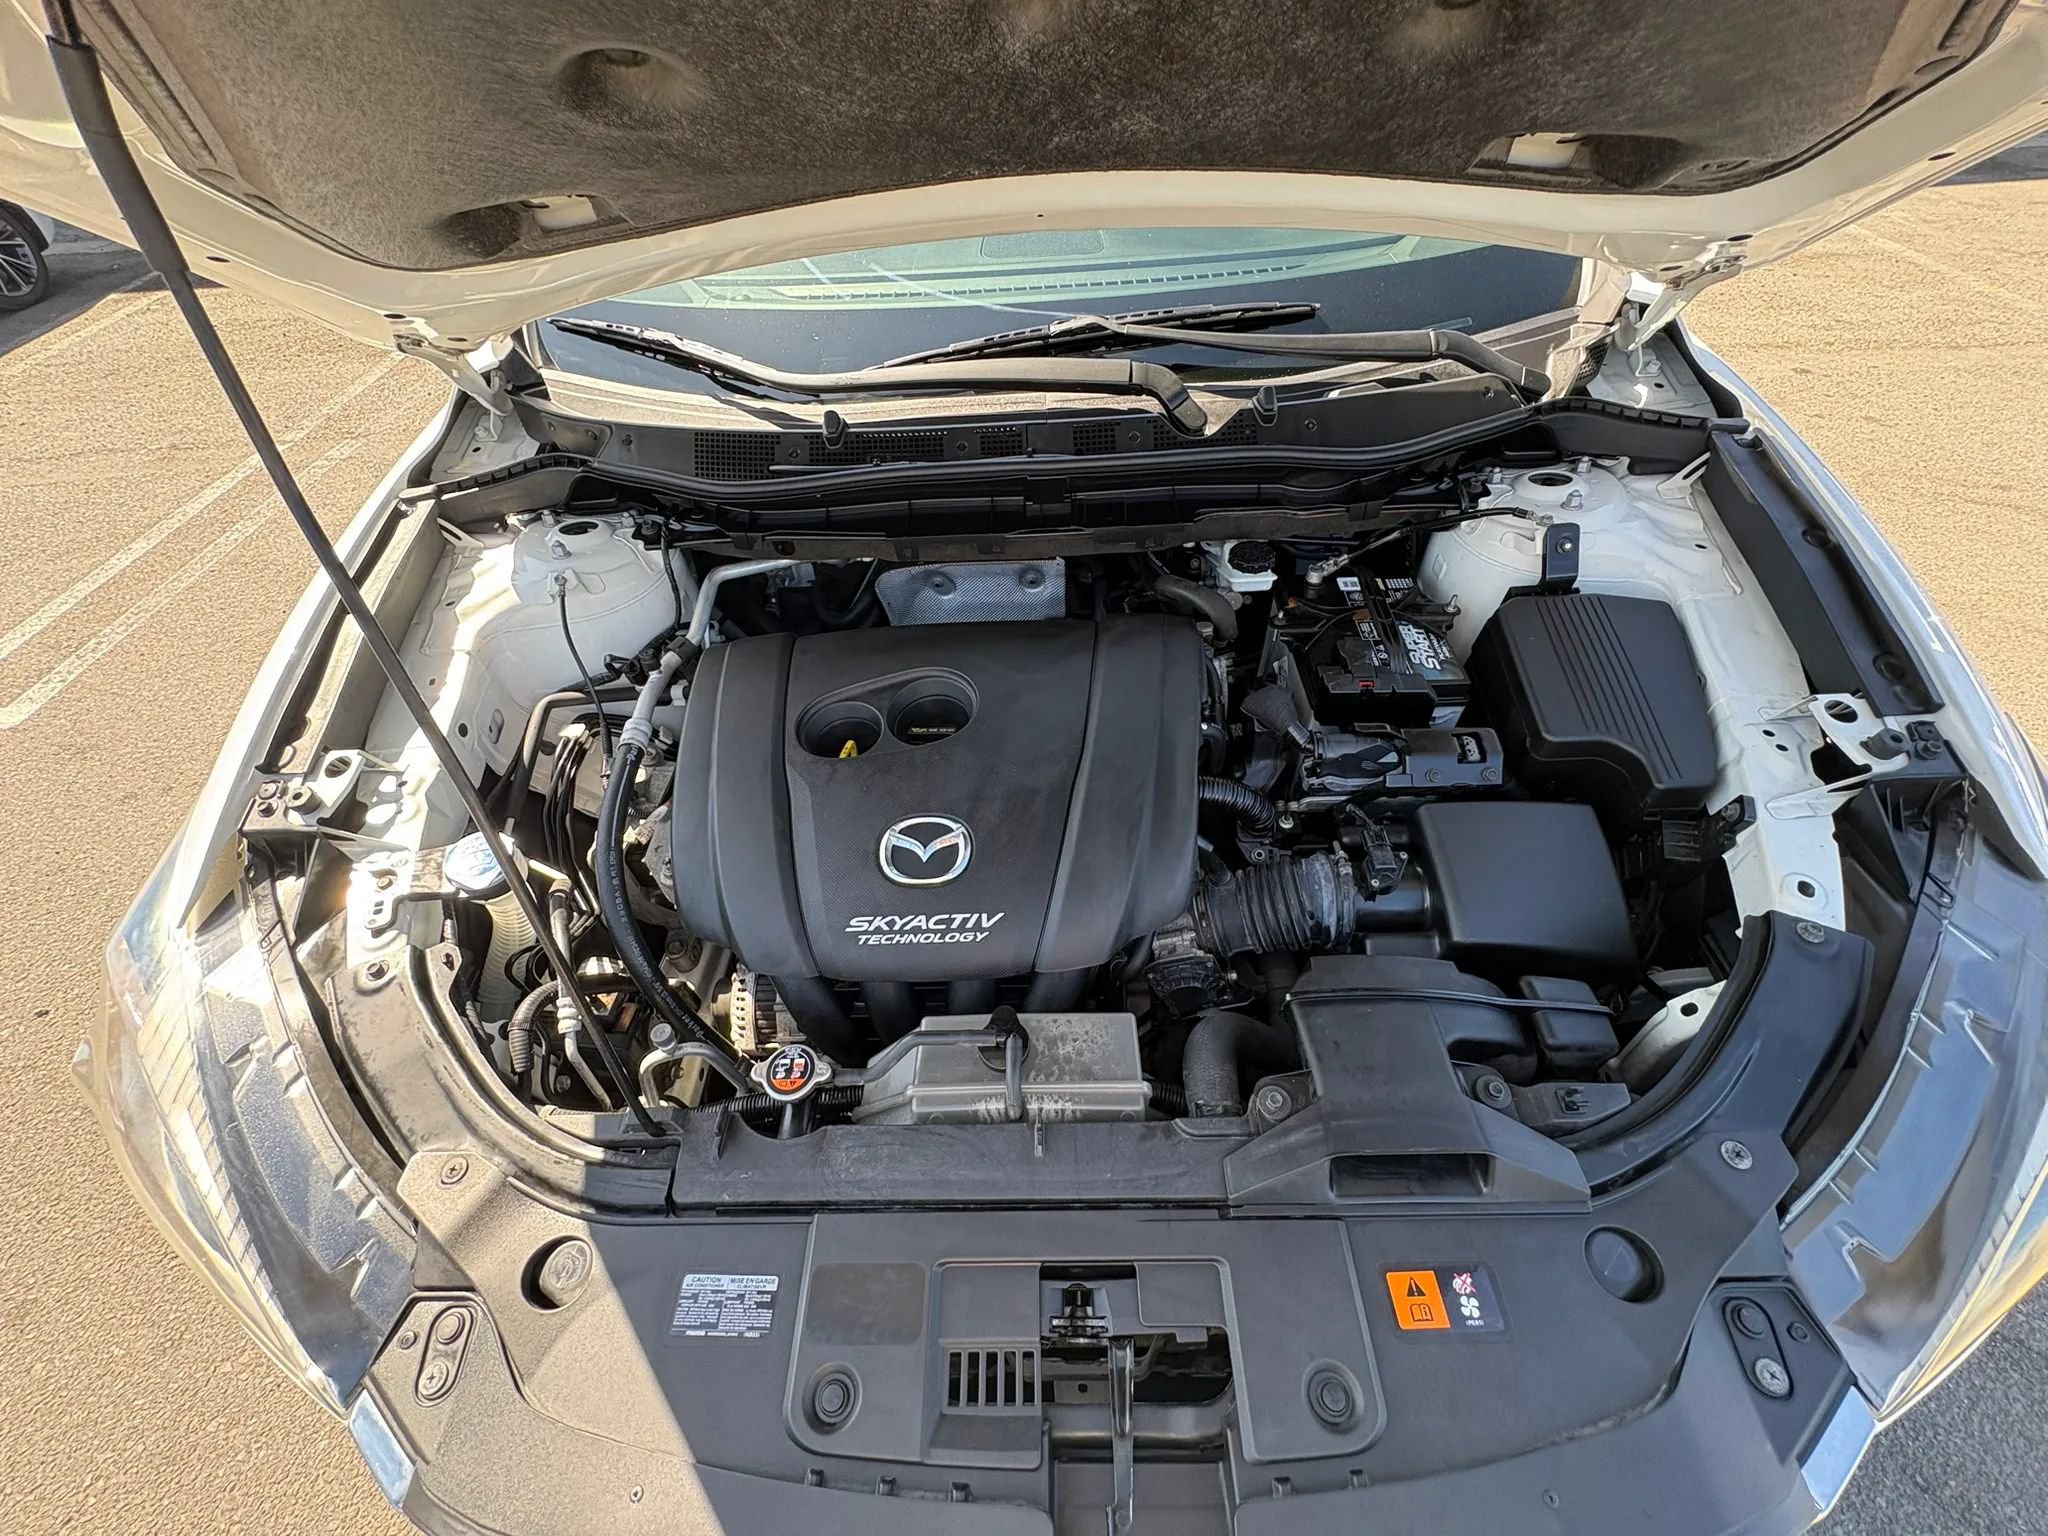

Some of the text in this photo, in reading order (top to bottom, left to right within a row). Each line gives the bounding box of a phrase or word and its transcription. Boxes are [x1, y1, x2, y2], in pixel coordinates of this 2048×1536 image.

[1398, 623, 1421, 664] SUPER
[1413, 627, 1441, 671] START
[845, 912, 1005, 932] SKYACTIV
[857, 931, 990, 945] TECHNOLOGY
